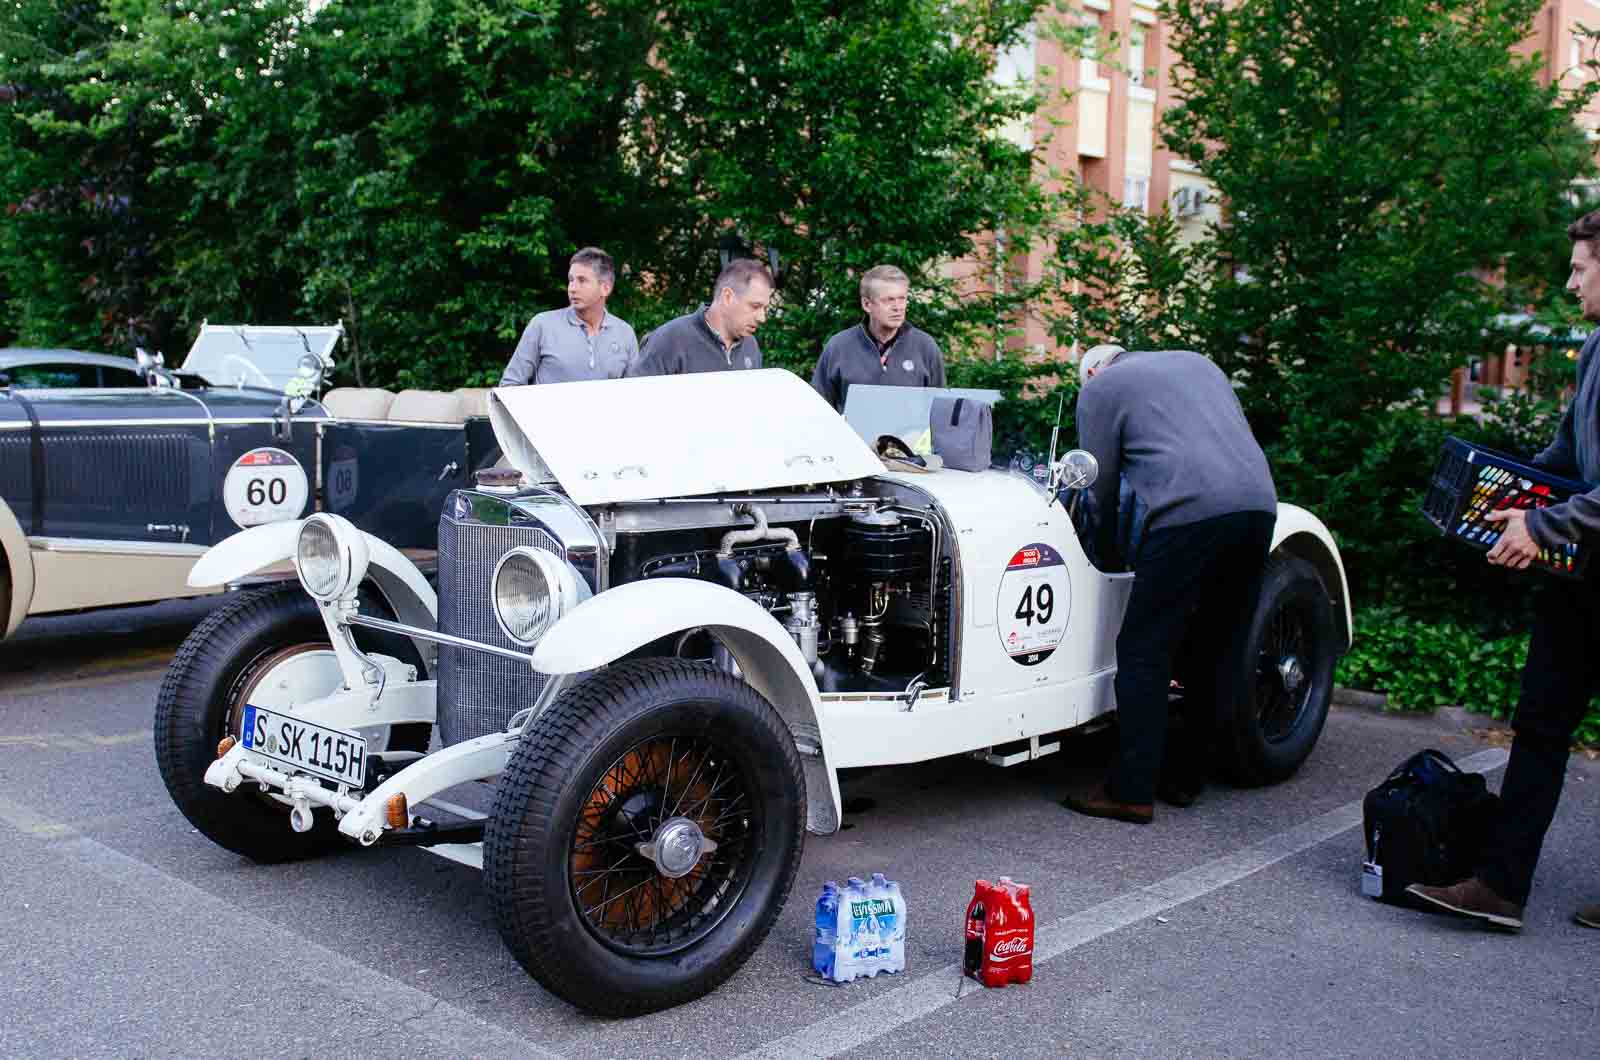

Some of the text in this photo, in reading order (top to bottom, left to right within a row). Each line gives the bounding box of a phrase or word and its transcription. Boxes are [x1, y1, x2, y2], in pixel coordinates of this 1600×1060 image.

[247, 478, 286, 506] 60
[1015, 583, 1054, 627] 49
[254, 715, 364, 780] S SK 115H
